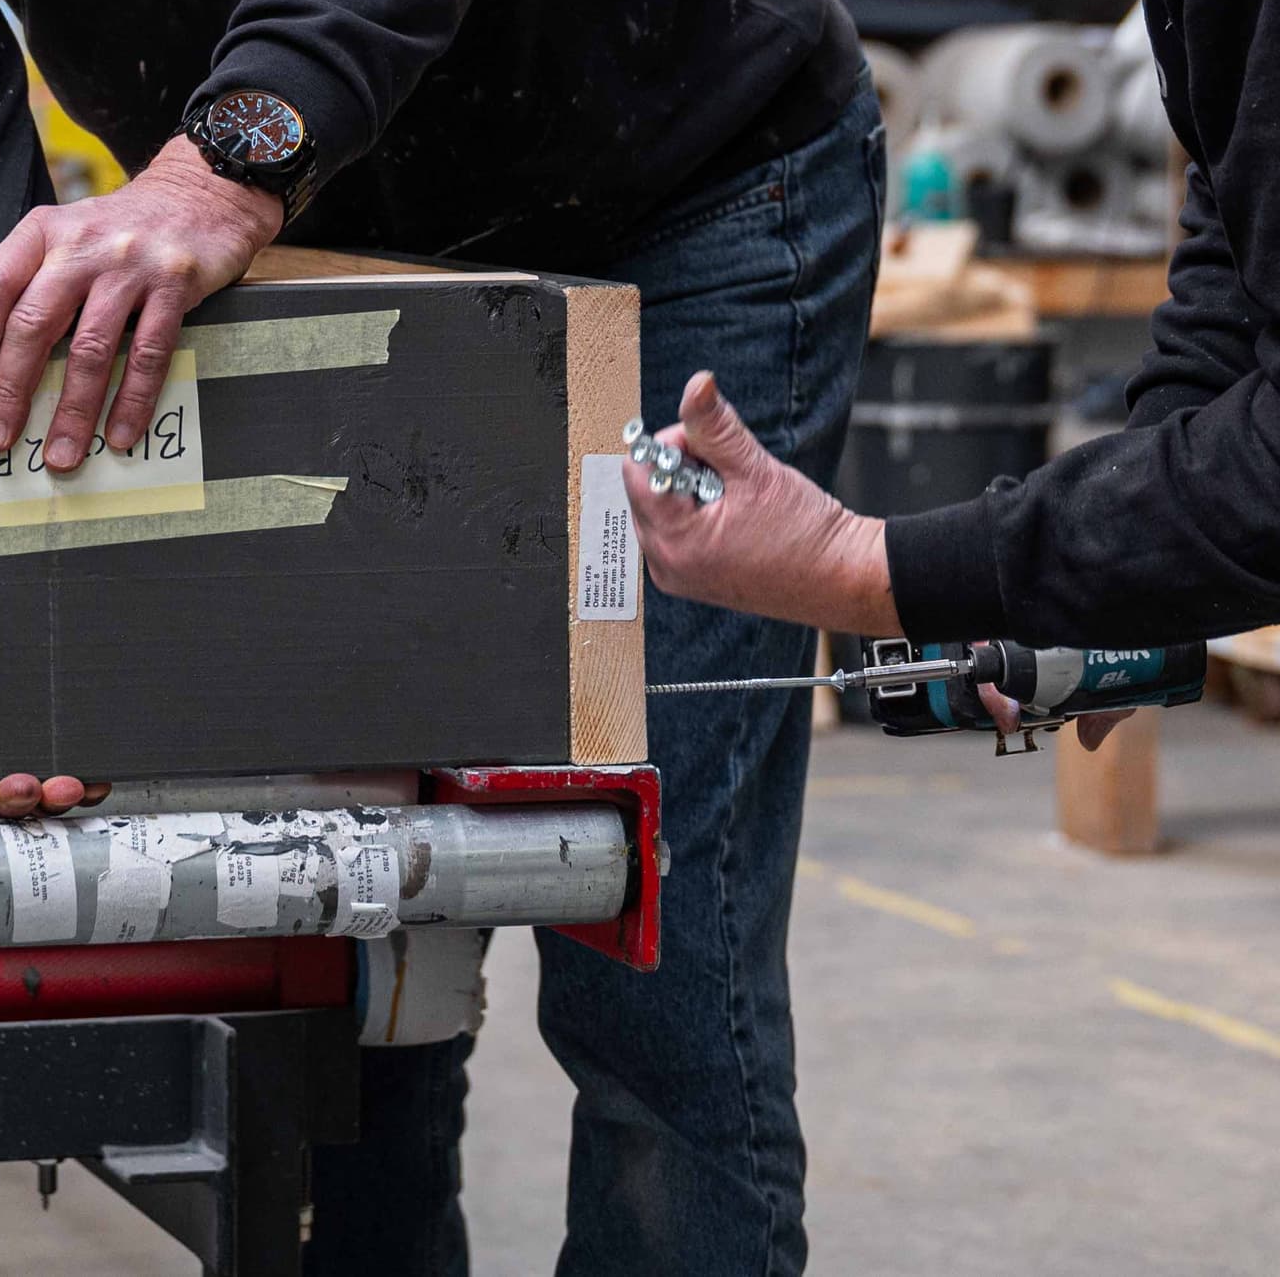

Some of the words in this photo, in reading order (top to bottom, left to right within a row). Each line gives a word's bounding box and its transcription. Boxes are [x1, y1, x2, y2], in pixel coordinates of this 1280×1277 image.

[610, 515, 618, 563] 20-12-2023
[619, 509, 627, 554] C00a-C03a
[618, 556, 626, 579] gevel
[584, 584, 592, 608] Merk:
[601, 568, 609, 608] Kopmaat:
[617, 581, 625, 608] Buiten
